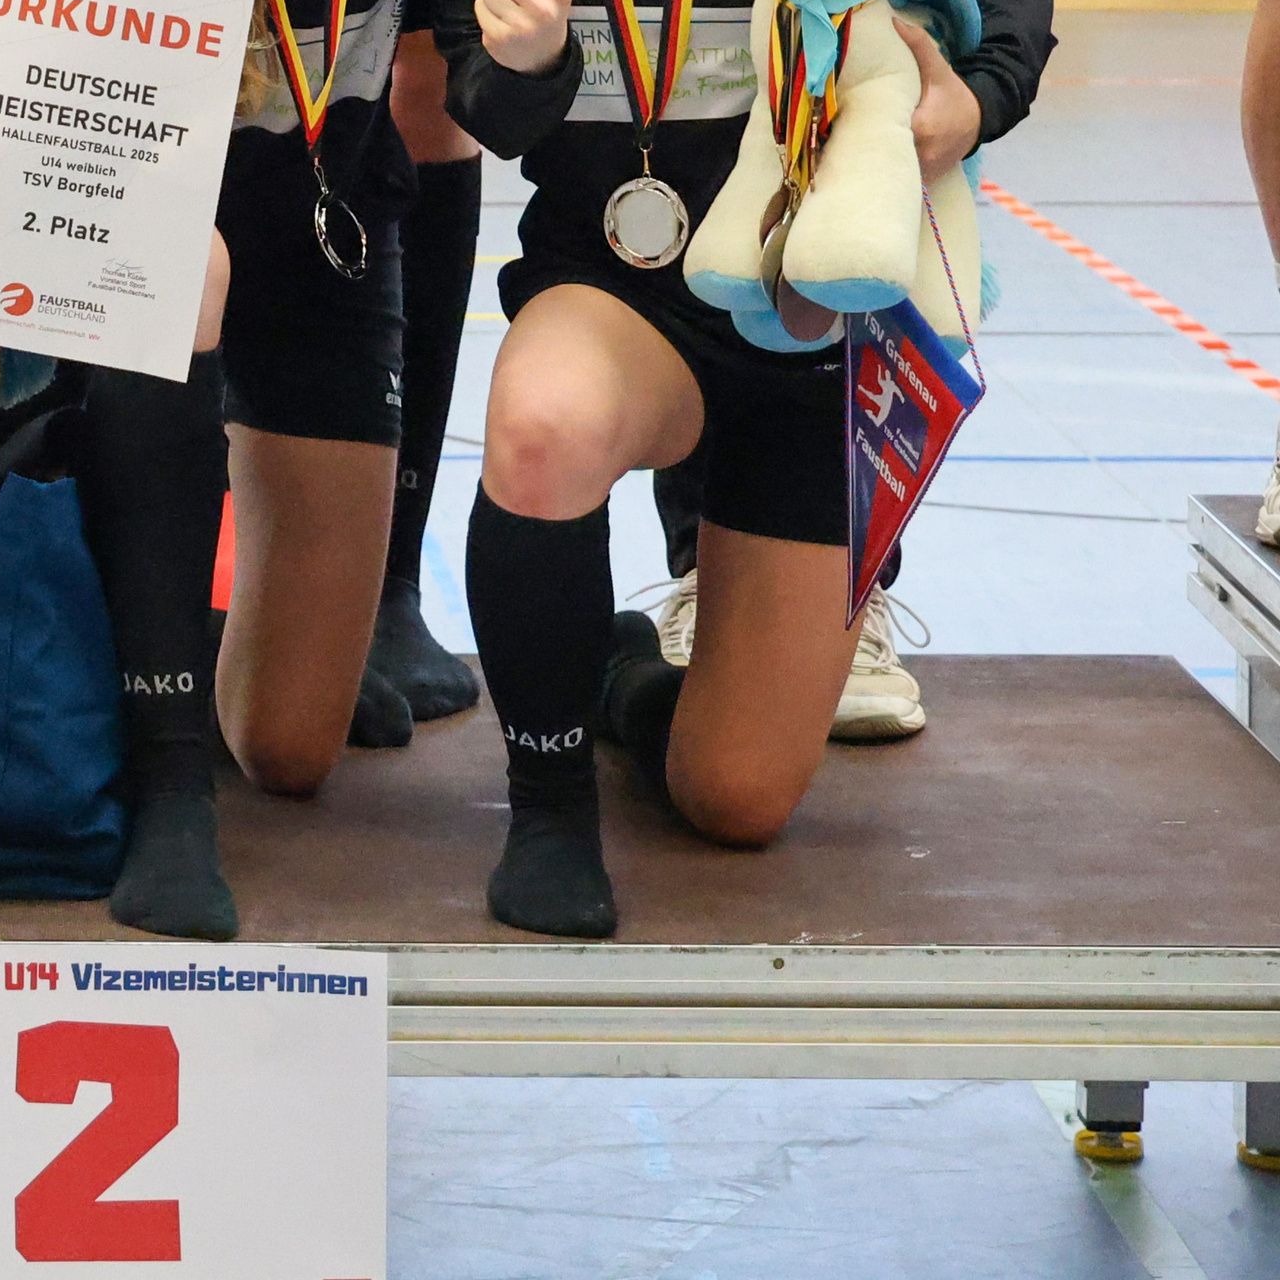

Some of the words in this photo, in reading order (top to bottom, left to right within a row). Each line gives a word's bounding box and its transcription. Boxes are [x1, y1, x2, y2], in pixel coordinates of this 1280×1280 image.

[26, 64, 158, 107] DEUTSCHE
[1, 126, 127, 158] HALLENFAUSTBALL
[131, 148, 160, 163] 2025
[41, 155, 62, 169] U14
[66, 161, 117, 177] weiblich
[22, 171, 53, 188] TSV
[57, 177, 125, 200] Borgfeld
[22, 211, 41, 233] 2.
[50, 215, 110, 244] Platz
[88, 281, 116, 292] Faustball
[117, 286, 156, 300] Deutschland
[129, 280, 147, 291] Sport
[37, 304, 106, 324] DEUTSCHLAND
[39, 294, 107, 315] FAUSTBALL
[865, 311, 885, 343] TSV
[885, 338, 938, 413] Grafenau
[855, 426, 907, 503] Faustball
[123, 670, 195, 695] JAKO
[504, 724, 584, 753] JAKO
[4, 961, 59, 991] U14
[71, 963, 368, 997] Vizemeisterinnen
[15, 1020, 182, 1262] 2
